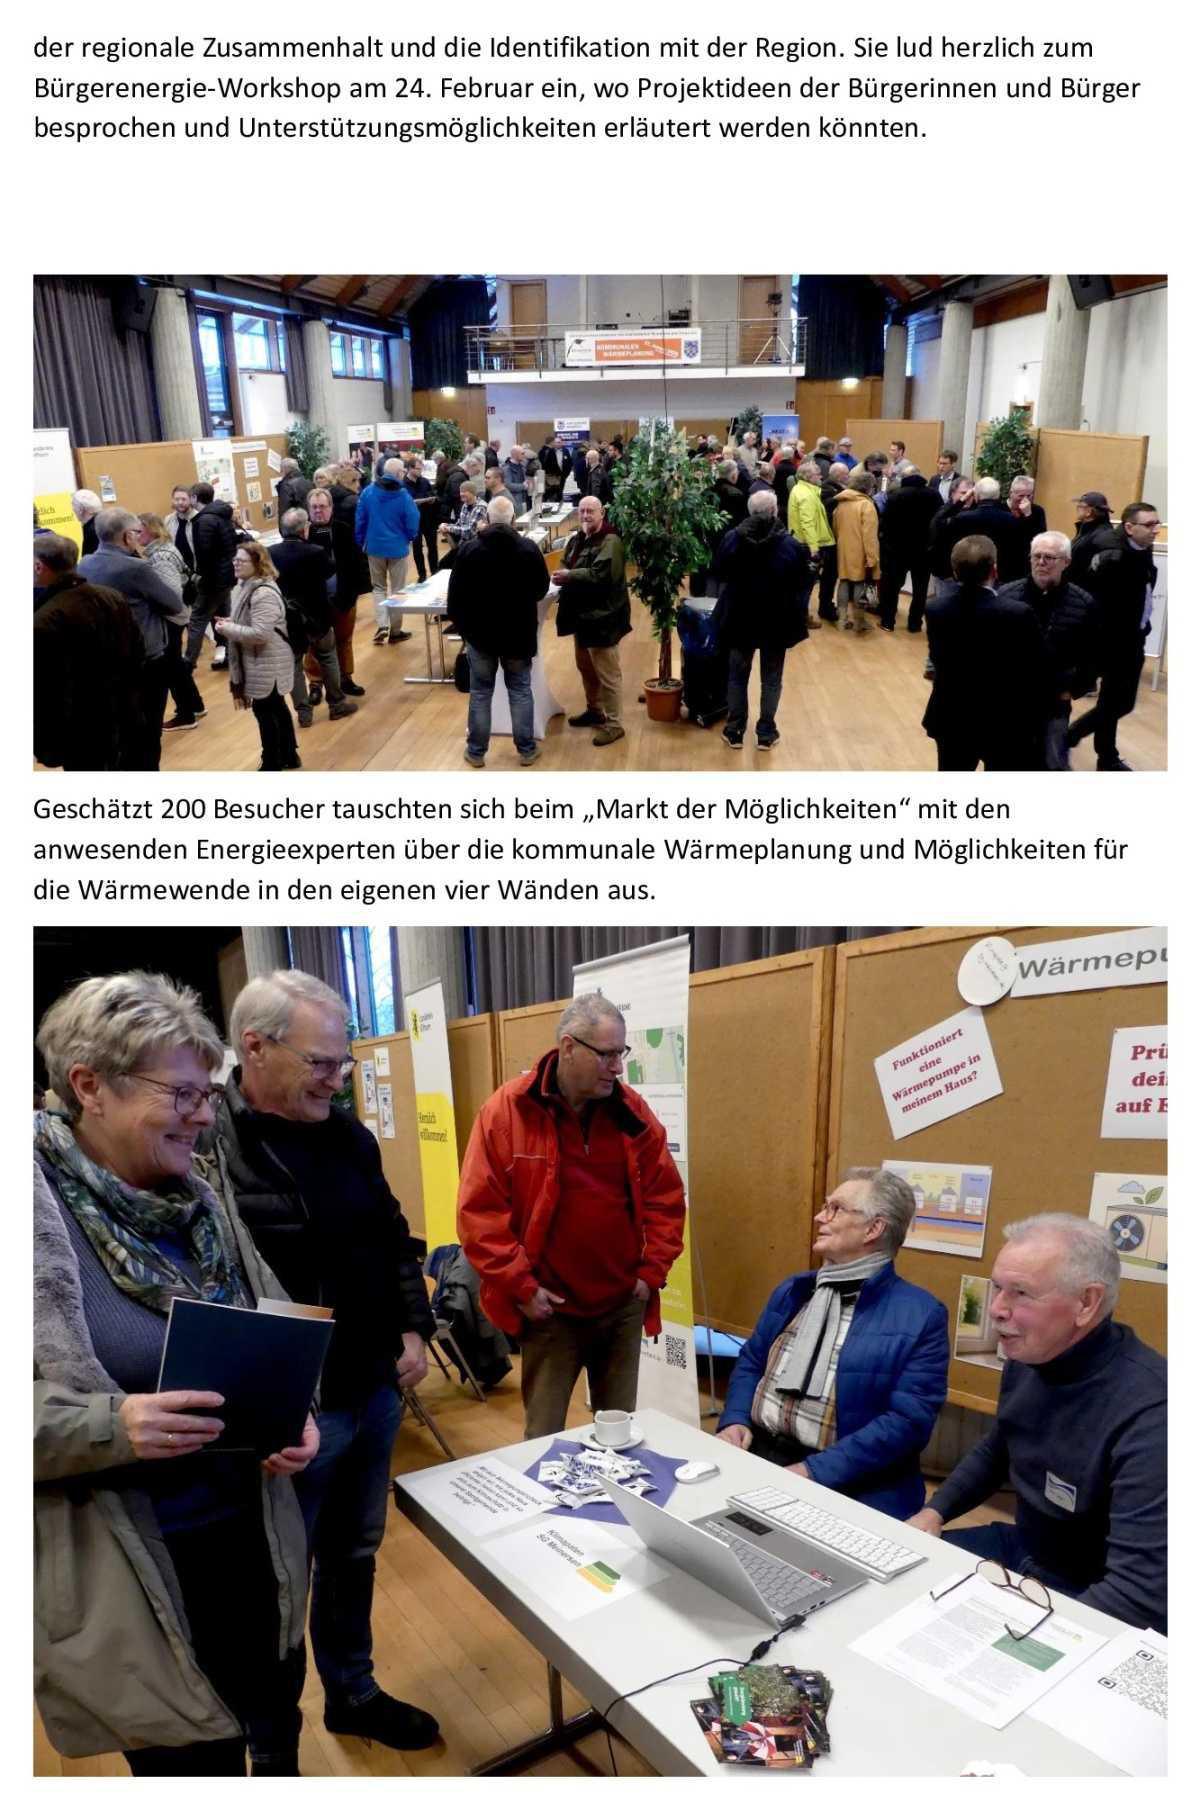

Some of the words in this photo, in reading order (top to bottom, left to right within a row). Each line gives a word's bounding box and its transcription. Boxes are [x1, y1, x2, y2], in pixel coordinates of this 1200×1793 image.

[33, 35, 75, 58] der
[82, 35, 194, 63] regionale
[202, 35, 384, 58] Zusammenhalt
[391, 35, 436, 58] und
[444, 35, 482, 58] die
[490, 35, 650, 58] Identifikation
[660, 37, 700, 58] mit
[707, 35, 748, 58] der
[756, 37, 845, 63] Region.
[853, 37, 889, 58] Sie
[897, 35, 933, 58] lud
[942, 35, 1034, 58] herzlich
[1043, 41, 1093, 58] zum
[35, 76, 341, 104] Bürgerenergie-Workshop
[349, 82, 387, 98] am
[395, 77, 431, 98] 24.
[441, 75, 535, 99] Februar
[541, 77, 585, 103] ein,
[593, 82, 629, 98] wo
[638, 75, 791, 104] Projektideen
[799, 75, 841, 98] der
[849, 77, 997, 104] Bürgerinnen
[1006, 76, 1051, 98] und
[1061, 77, 1142, 104] Bürger
[35, 115, 176, 143] besprochen
[184, 115, 230, 138] und
[239, 115, 596, 143] Unterstützungsmöglichkeiten
[604, 115, 711, 138] erläutert
[718, 115, 810, 138] werden
[819, 115, 926, 138] könnten.
[33, 797, 153, 820] Geschätzt
[161, 798, 206, 820] 200
[214, 797, 326, 820] Besucher
[332, 797, 452, 820] tauschten
[460, 797, 505, 820] sich
[514, 797, 574, 819] beim
[582, 797, 669, 824] „Markt
[676, 797, 717, 819] der
[725, 797, 911, 825] Möglichkeiten“
[918, 798, 958, 819] mit
[965, 797, 1010, 820] den
[33, 837, 187, 860] anwesenden
[197, 839, 395, 865] Energieexperten
[404, 837, 461, 860] über
[467, 837, 504, 860] die
[512, 837, 655, 860] kommunale
[663, 837, 852, 865] Wärmeplanung
[860, 837, 905, 860] und
[914, 837, 1086, 865] Möglichkeiten
[1093, 837, 1129, 860] für
[33, 878, 70, 901] die
[77, 878, 250, 901] Wärmewende
[258, 879, 279, 900] in
[287, 878, 332, 901] den
[340, 879, 436, 906] eigenen
[444, 879, 491, 901] vier
[497, 878, 599, 901] Wänden
[608, 884, 656, 900] aus.
[891, 1027, 964, 1072] Funktioniert
[891, 1060, 967, 1102] Wärmepumpe
[967, 1053, 982, 1067] in
[918, 1056, 943, 1073] eine
[901, 1089, 944, 1114] meinem
[943, 1069, 978, 1094] Haus?
[1131, 1071, 1168, 1087] dei
[1115, 1097, 1153, 1114] auf
